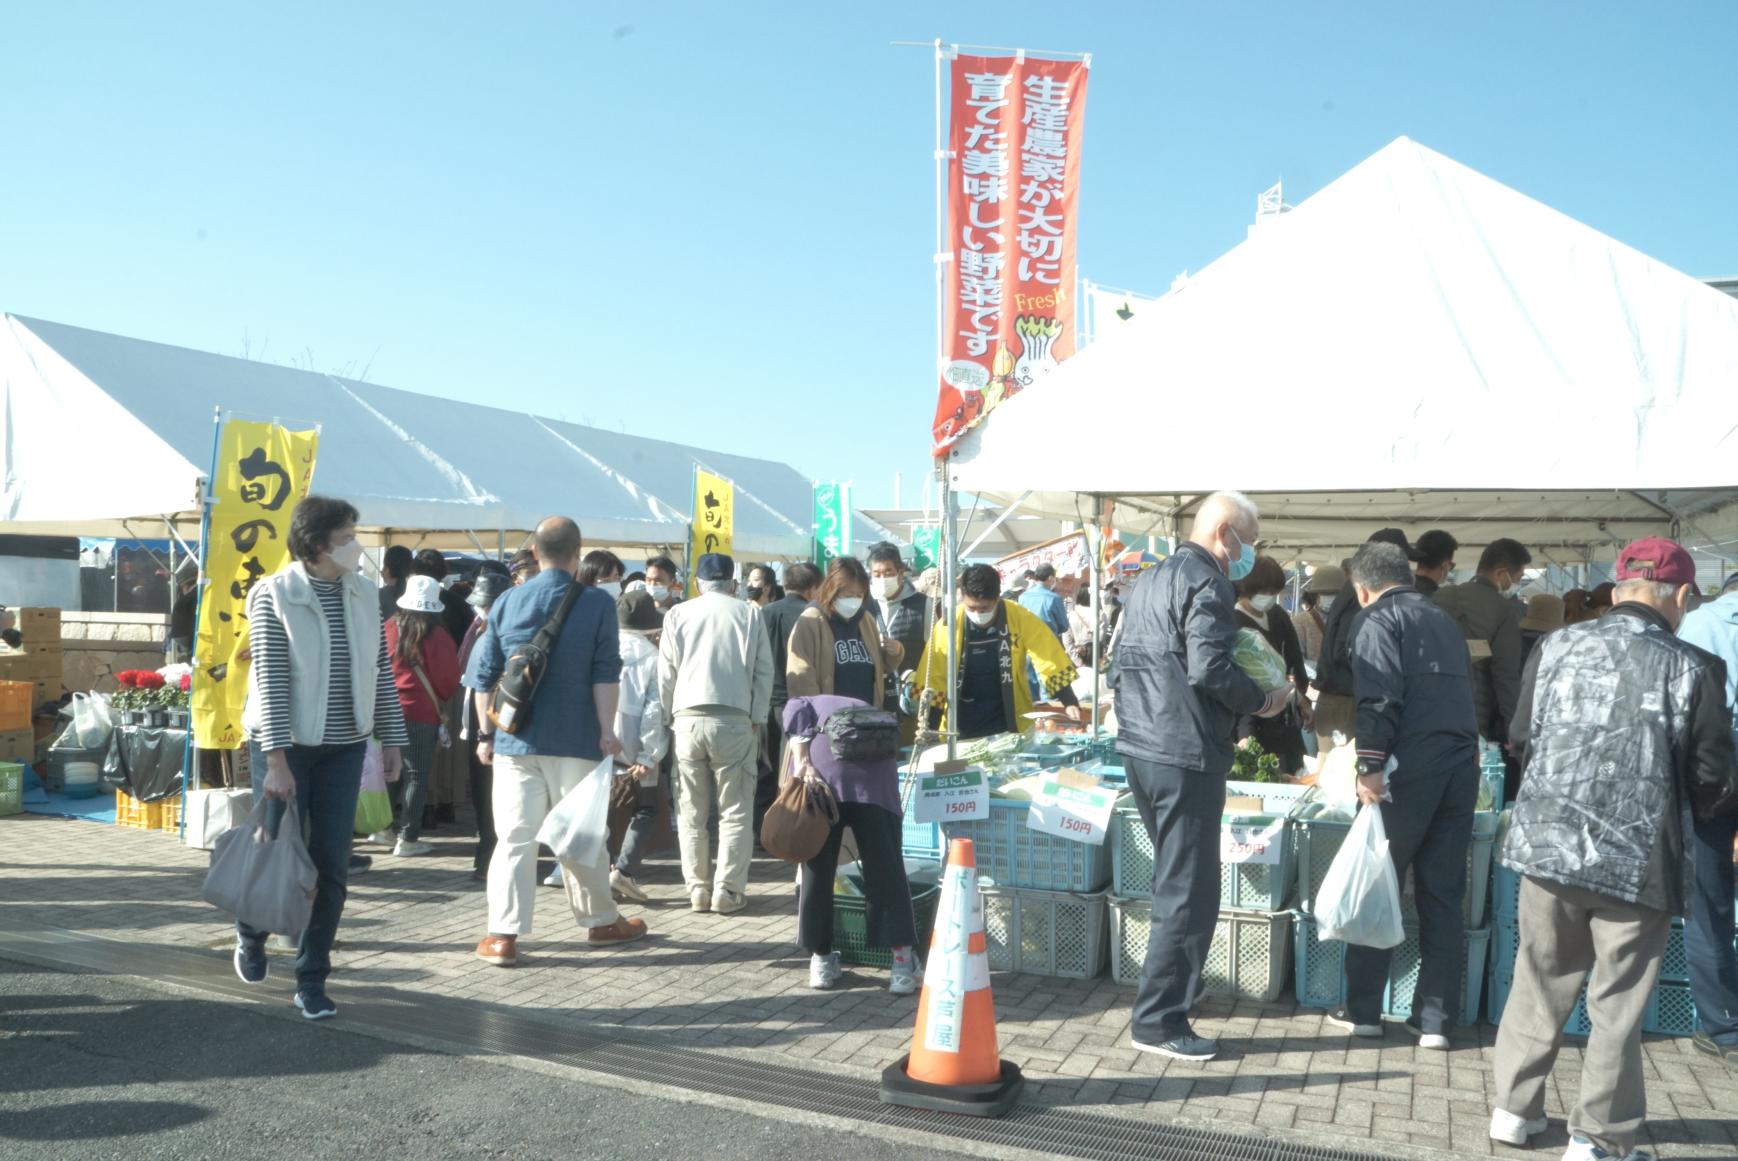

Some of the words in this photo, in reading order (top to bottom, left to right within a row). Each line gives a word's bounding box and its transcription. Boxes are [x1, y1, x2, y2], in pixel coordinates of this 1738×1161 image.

[1015, 74, 1070, 285] 生産農家が大切に
[959, 72, 1014, 357] 育てた美味しい野菜です
[1014, 287, 1068, 312] Fresh
[945, 801, 976, 814] 150円
[1060, 816, 1092, 835] 150円
[1229, 843, 1265, 855] 250円
